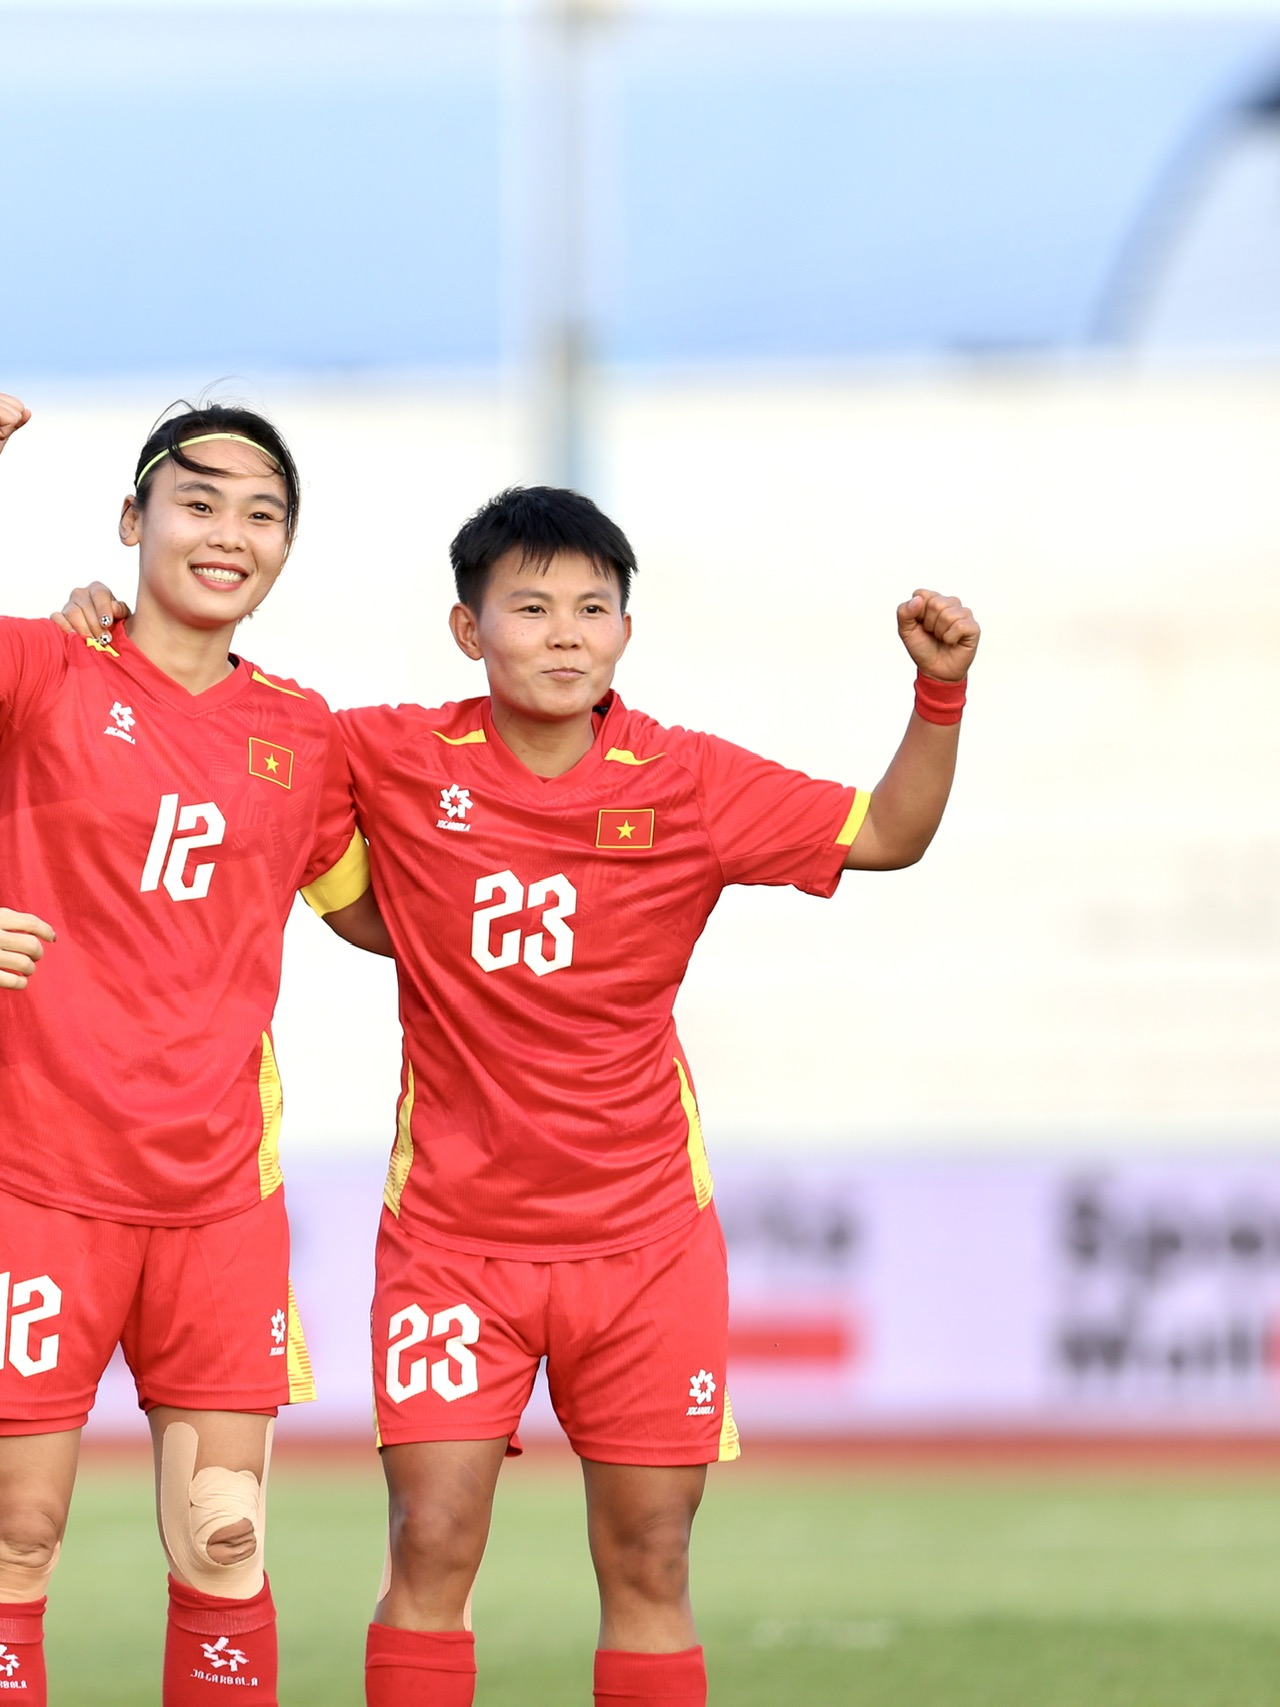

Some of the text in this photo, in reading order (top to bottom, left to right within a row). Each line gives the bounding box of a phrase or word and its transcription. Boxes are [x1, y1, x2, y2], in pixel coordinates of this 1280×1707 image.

[140, 793, 227, 902] 12
[471, 869, 577, 977] 23
[386, 1303, 480, 1404] 23
[189, 1668, 259, 1687] JOGARBOLA
